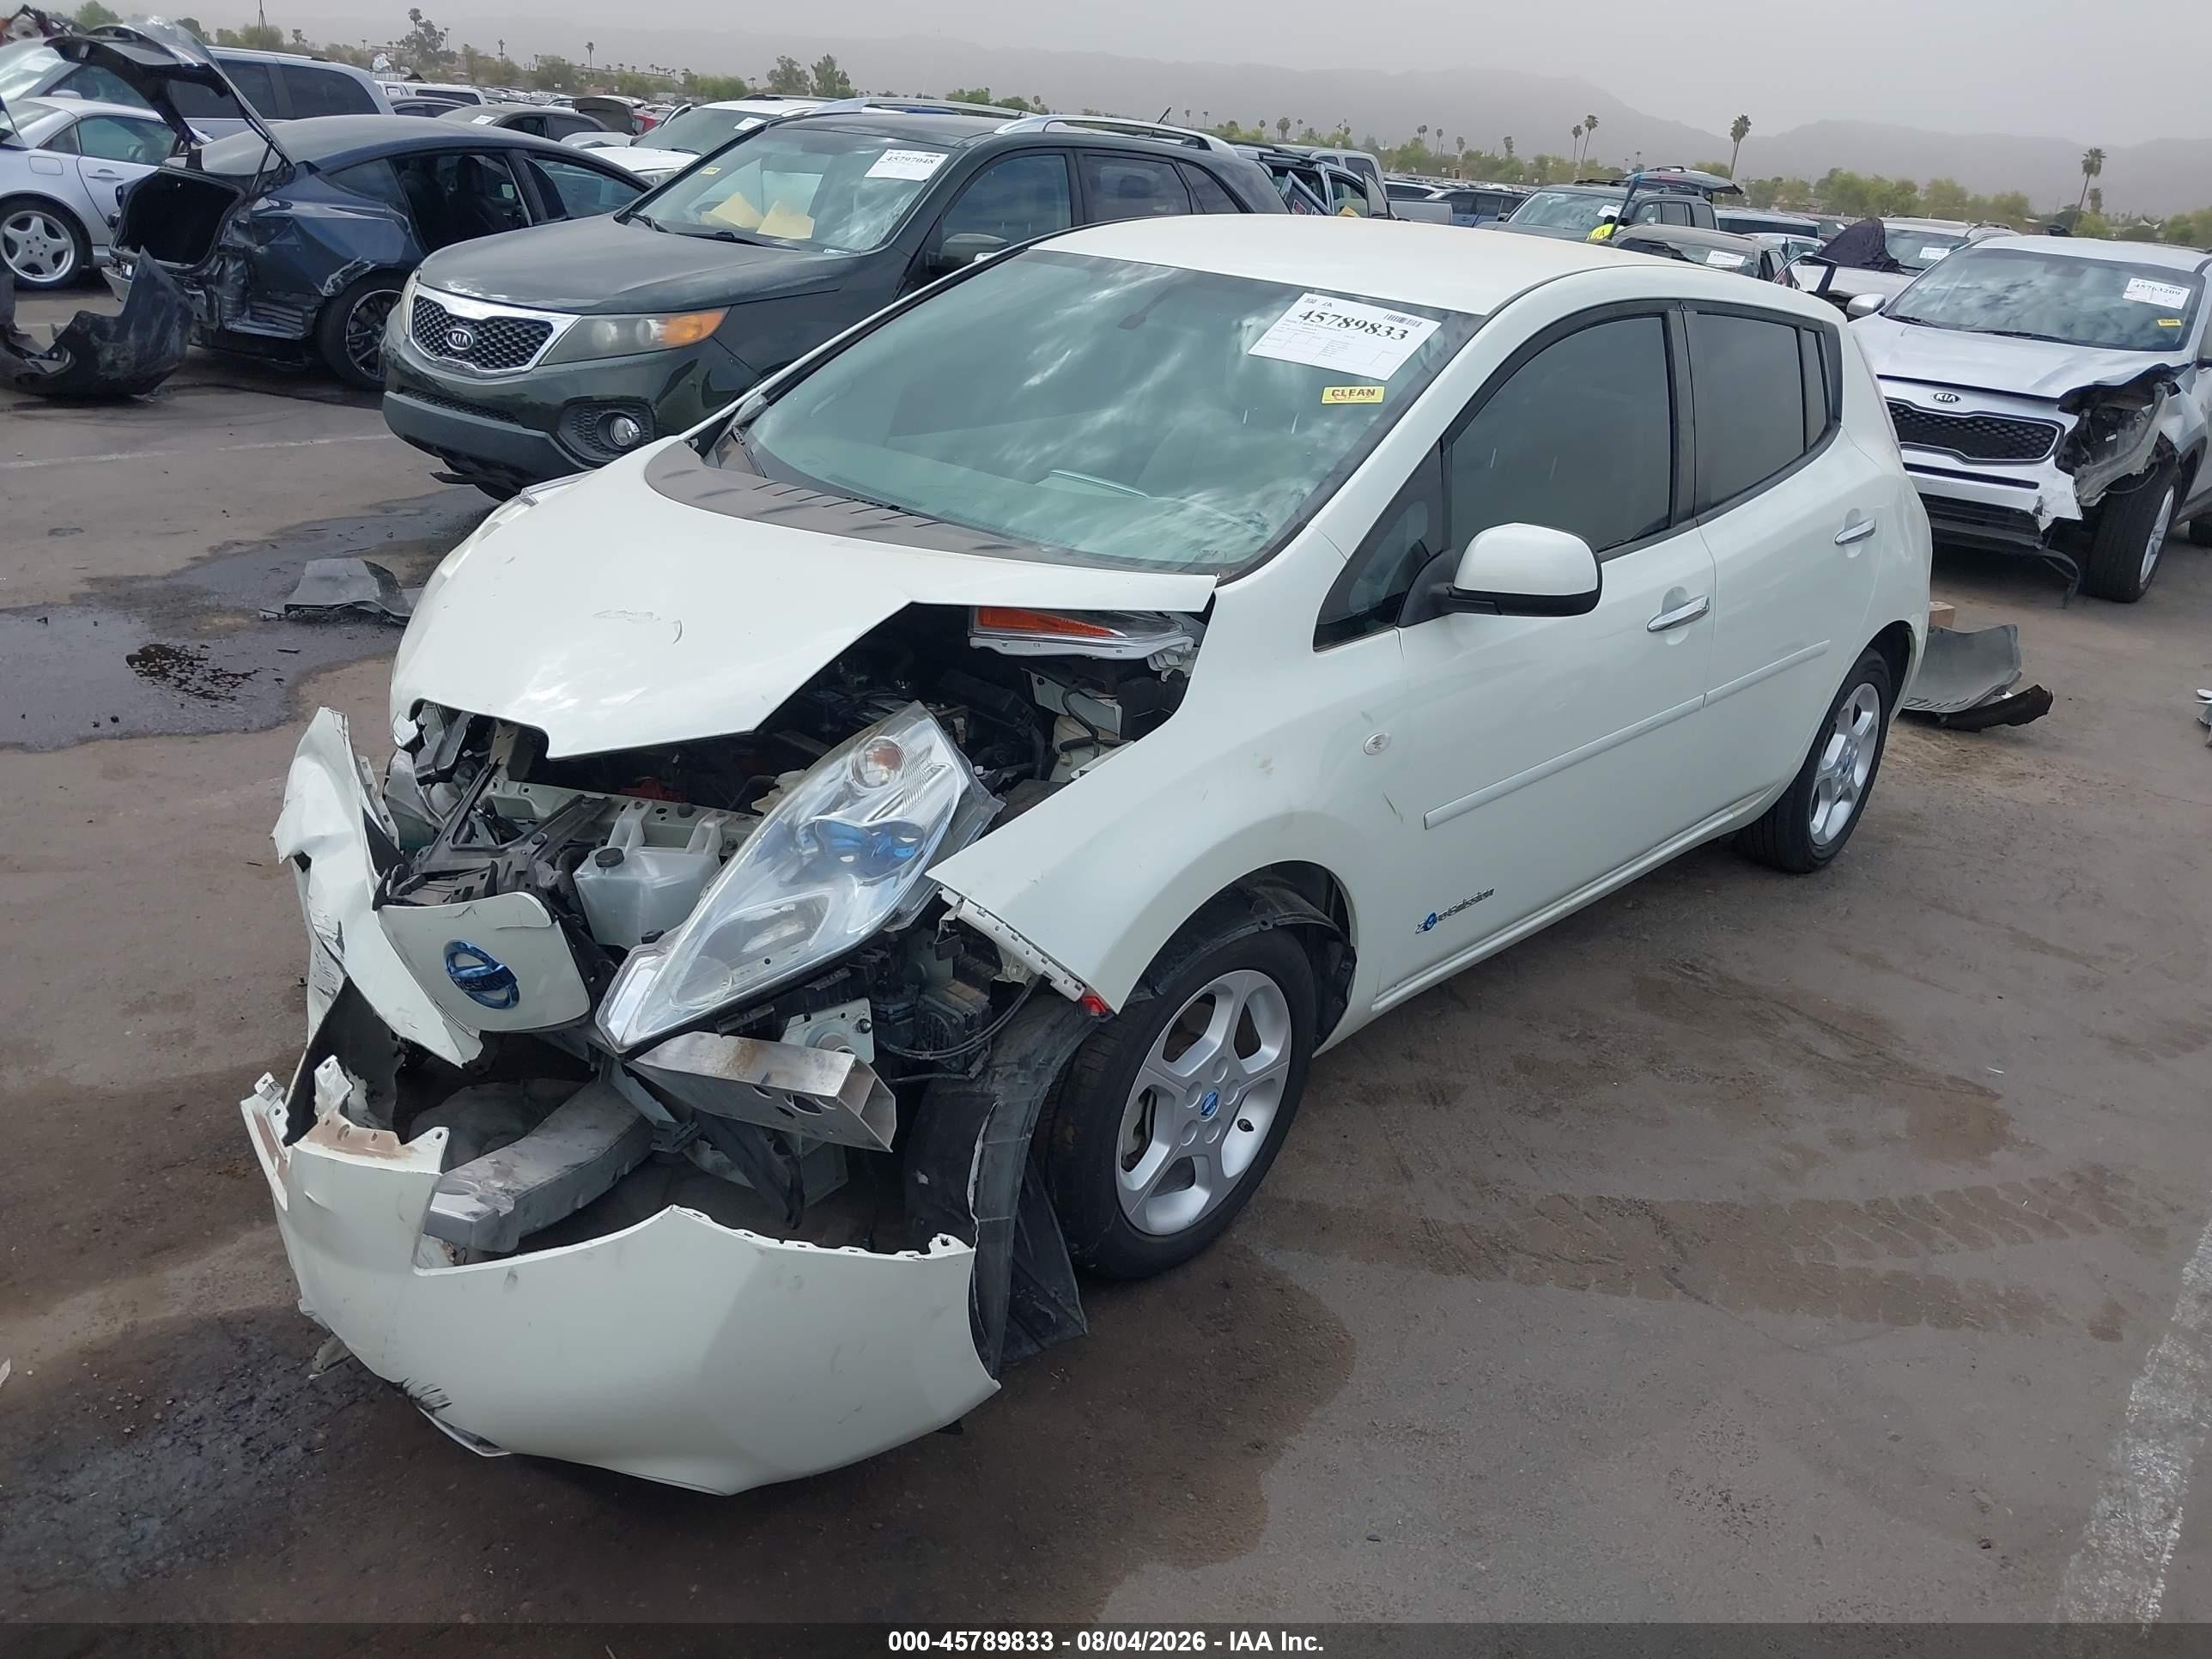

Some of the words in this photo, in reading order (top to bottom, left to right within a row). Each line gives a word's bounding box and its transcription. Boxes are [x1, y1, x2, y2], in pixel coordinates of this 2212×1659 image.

[1298, 309, 1409, 341] 45789833
[452, 332, 468, 346] KIA
[1332, 388, 1376, 397] CLEAN
